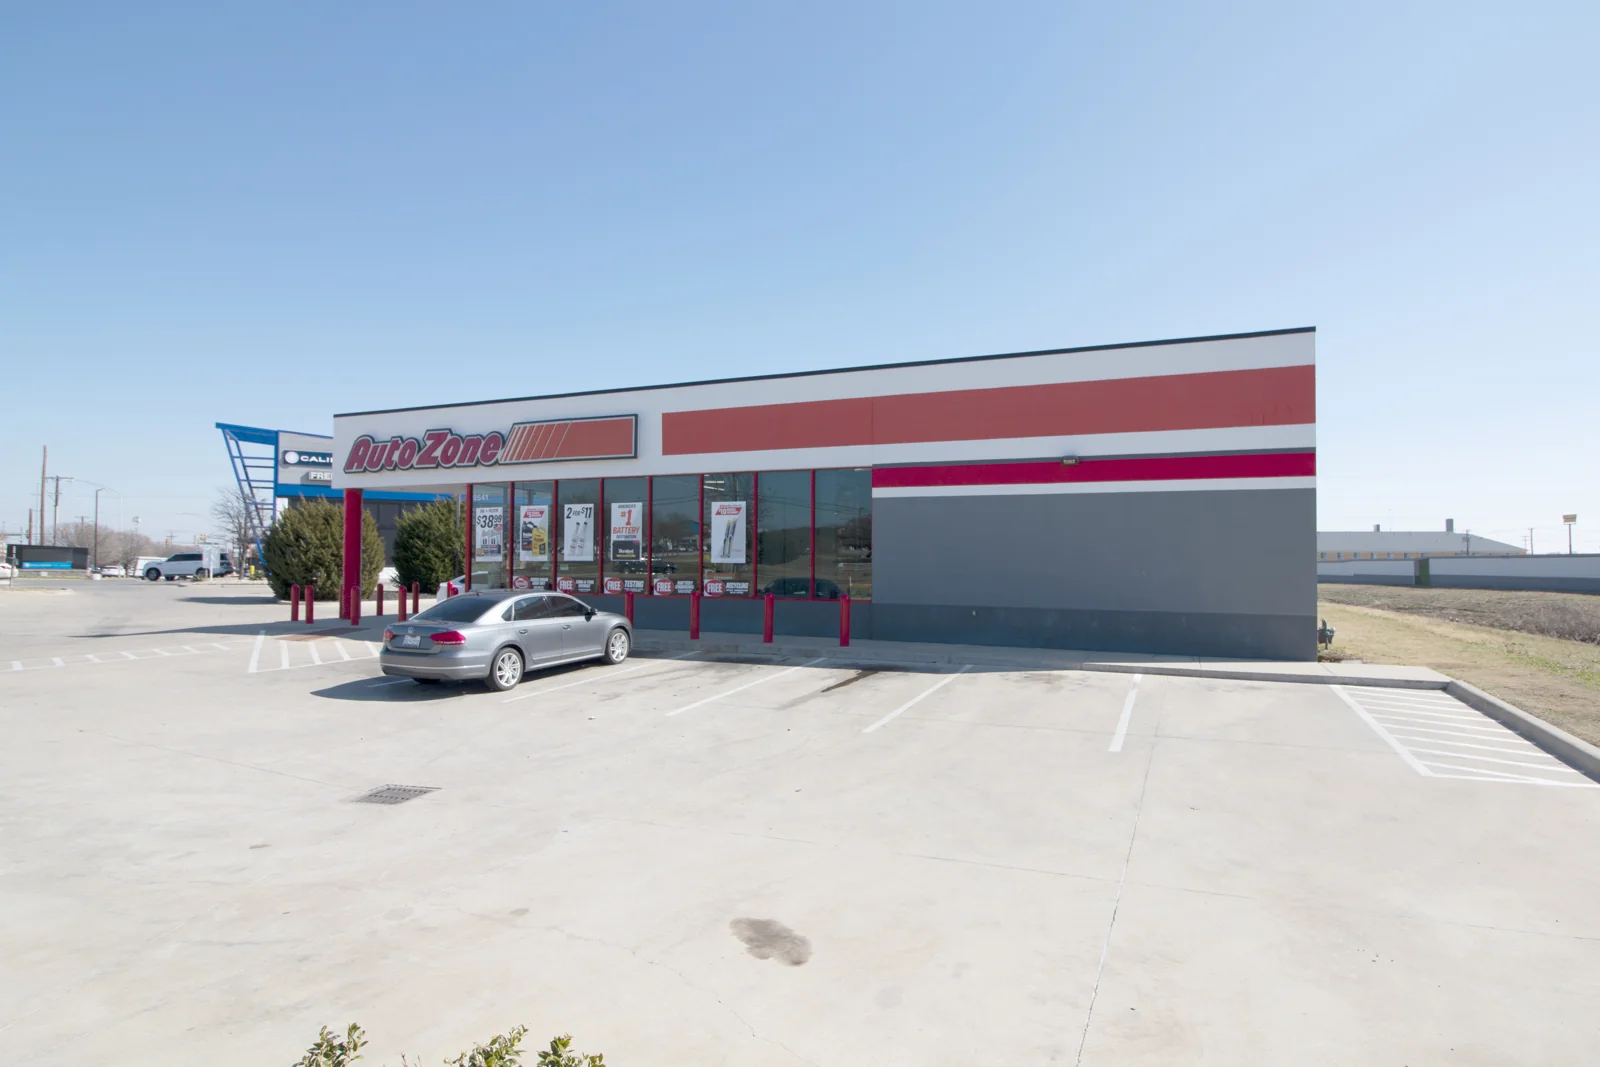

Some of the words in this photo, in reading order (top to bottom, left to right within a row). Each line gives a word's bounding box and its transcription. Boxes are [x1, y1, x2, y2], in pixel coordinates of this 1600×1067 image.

[344, 428, 504, 473] AutoZone
[566, 507, 573, 519] 2
[580, 506, 592, 518] $11
[620, 509, 632, 526] #1
[613, 526, 640, 534] BATTERY
[560, 580, 572, 590] FREE
[608, 581, 620, 590] FREE
[656, 582, 671, 592] FREE
[707, 583, 722, 592] FREE
